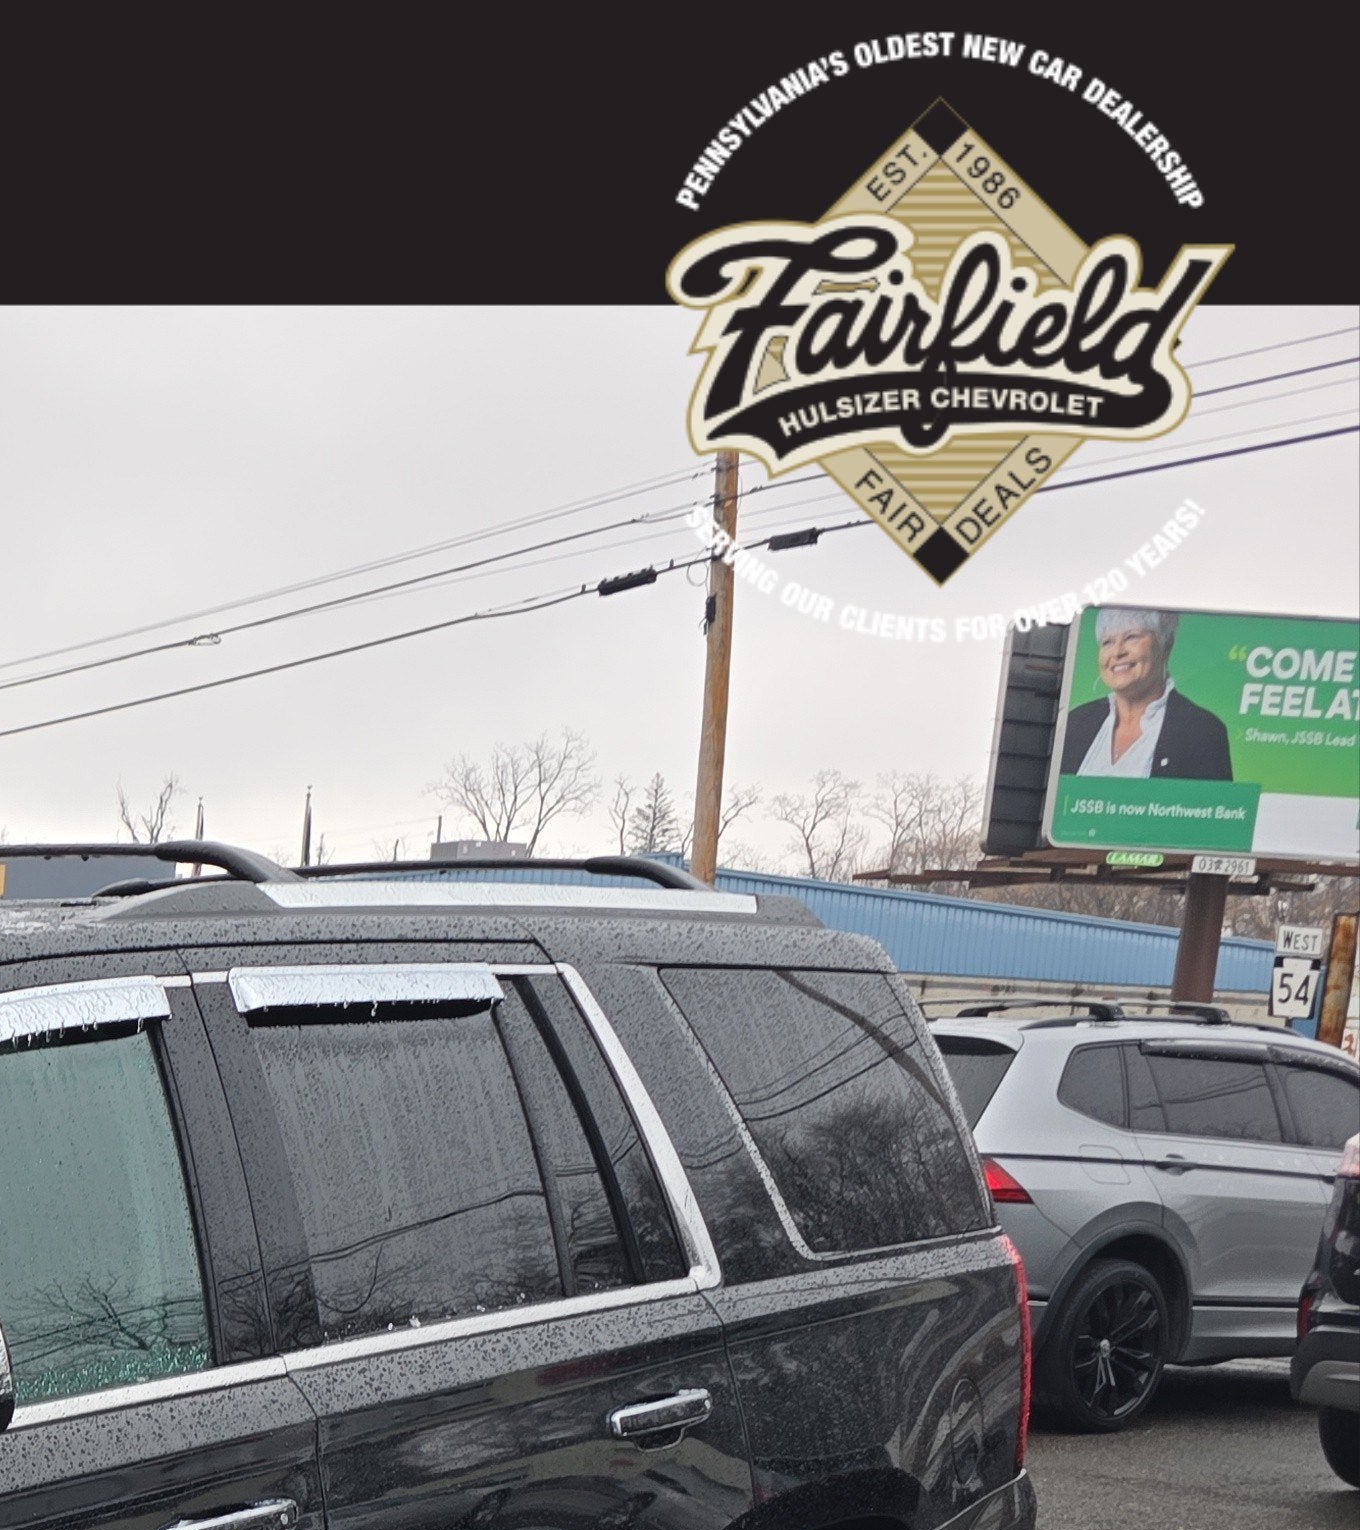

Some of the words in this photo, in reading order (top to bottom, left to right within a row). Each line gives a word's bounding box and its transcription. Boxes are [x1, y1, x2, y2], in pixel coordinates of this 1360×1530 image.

[1240, 683, 1322, 718] FEEL
[1106, 801, 1116, 814] is
[1119, 804, 1146, 815] now
[1148, 803, 1213, 819] Northwest
[1215, 806, 1247, 820] Bank
[1283, 930, 1318, 951] WEST
[1278, 973, 1311, 1006] 54
